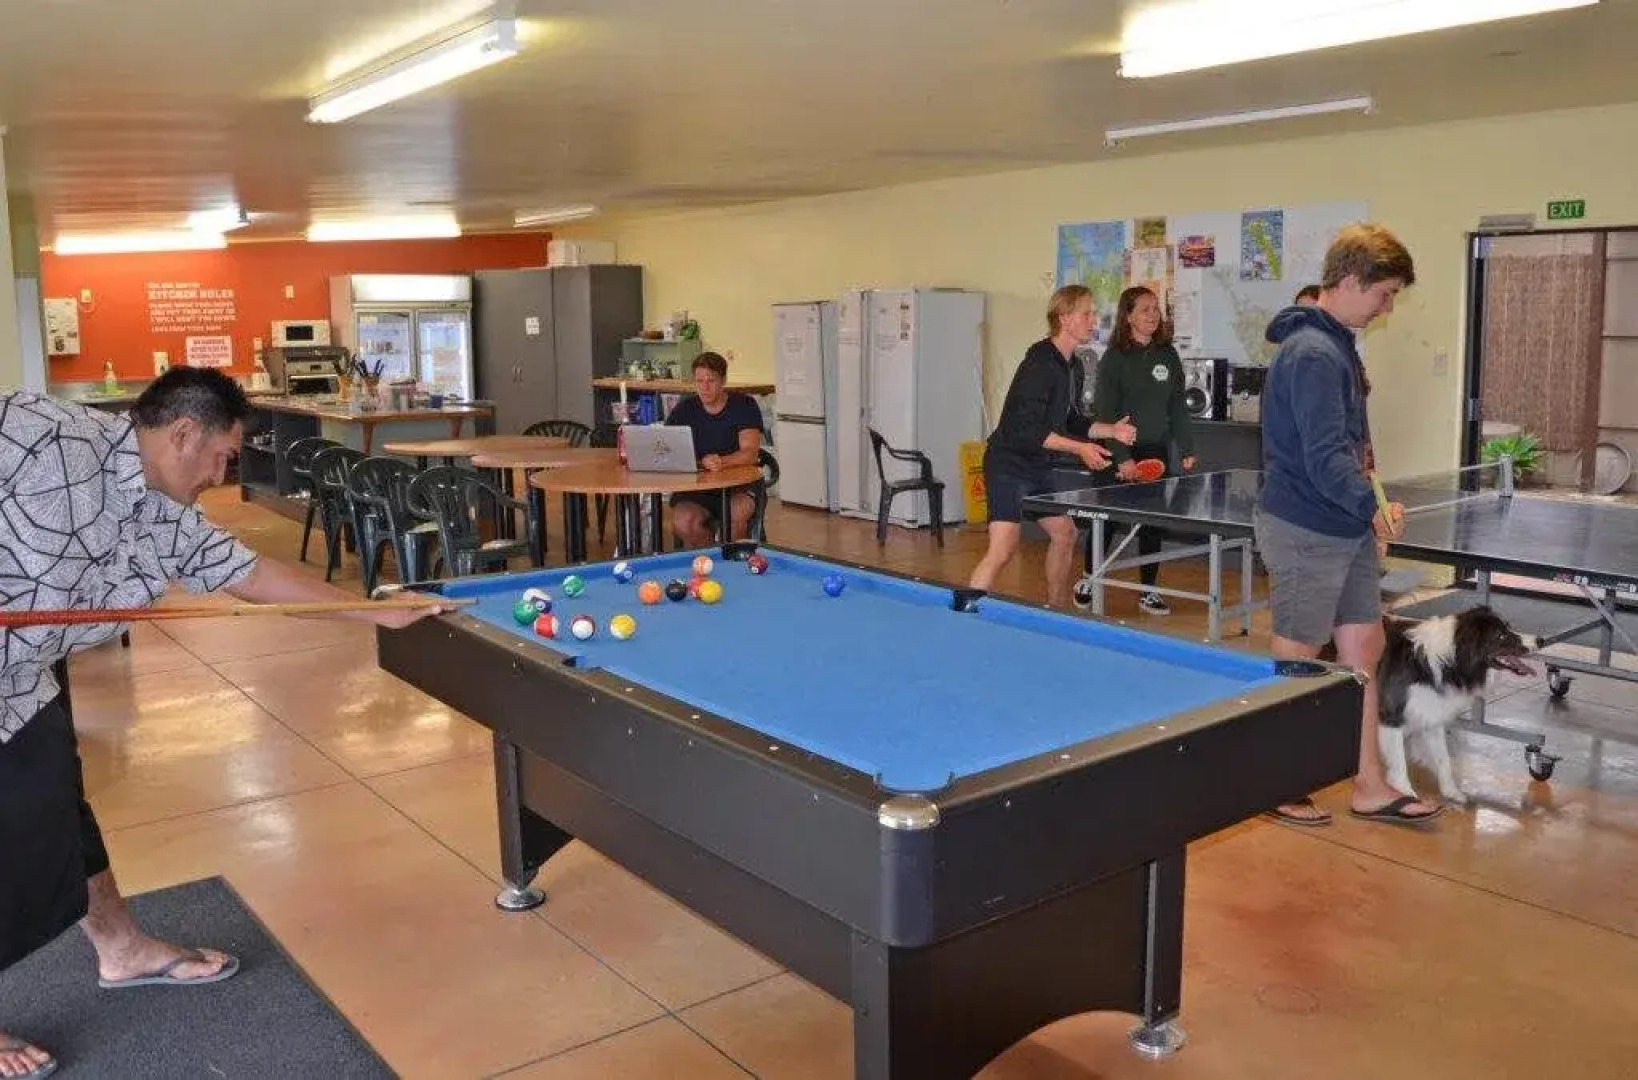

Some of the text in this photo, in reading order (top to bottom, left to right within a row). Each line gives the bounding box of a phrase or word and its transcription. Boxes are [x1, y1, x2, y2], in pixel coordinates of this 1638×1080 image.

[1551, 203, 1582, 217] EXIT
[148, 289, 234, 300] KITCHEN RULES
